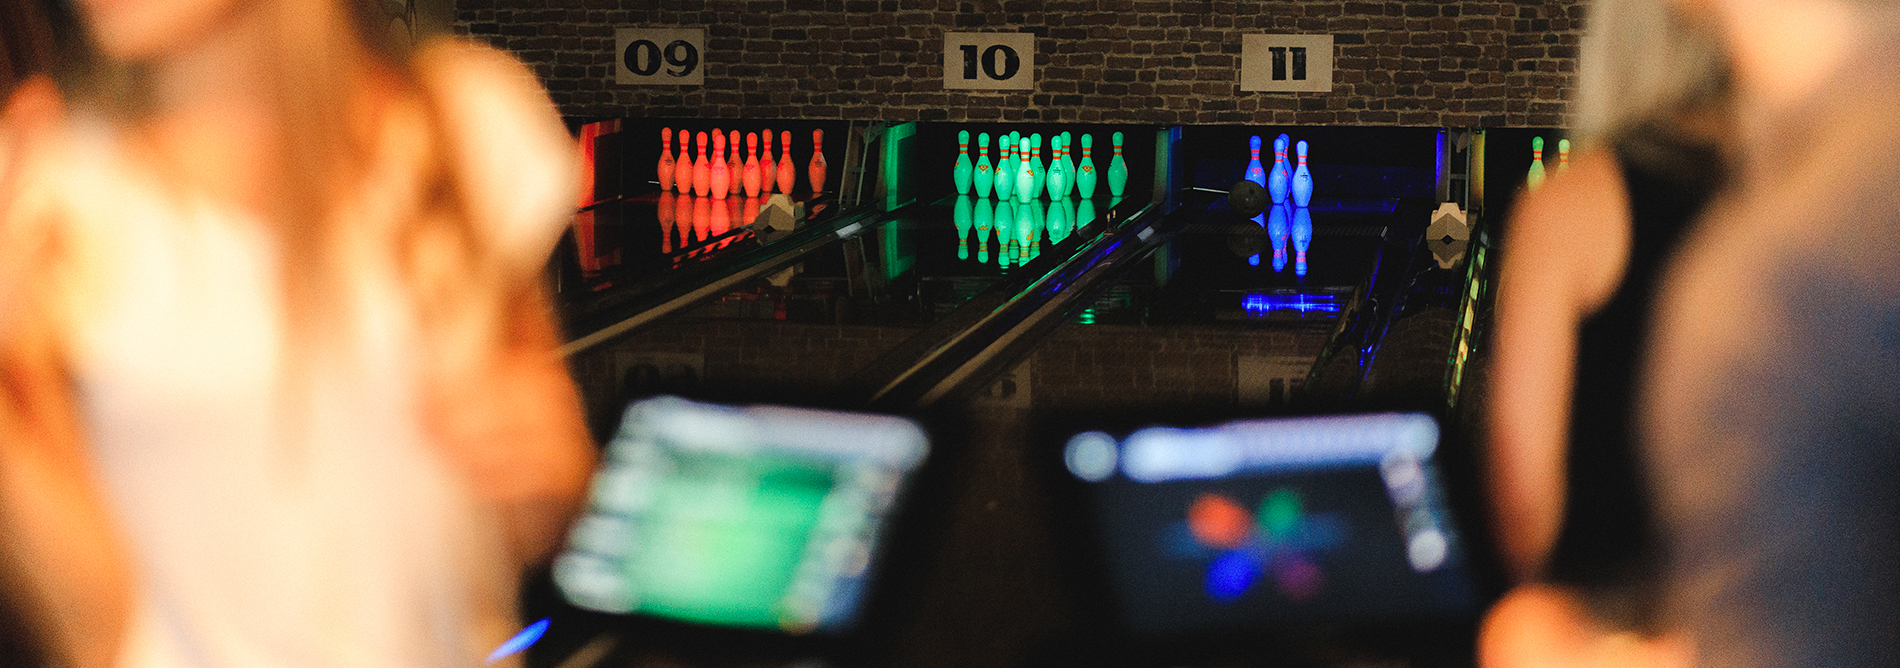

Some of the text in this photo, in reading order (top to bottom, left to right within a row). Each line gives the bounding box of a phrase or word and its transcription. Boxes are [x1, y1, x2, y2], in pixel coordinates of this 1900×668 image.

[624, 39, 698, 77] 09
[960, 44, 1020, 80] 10
[1268, 47, 1306, 80] 11
